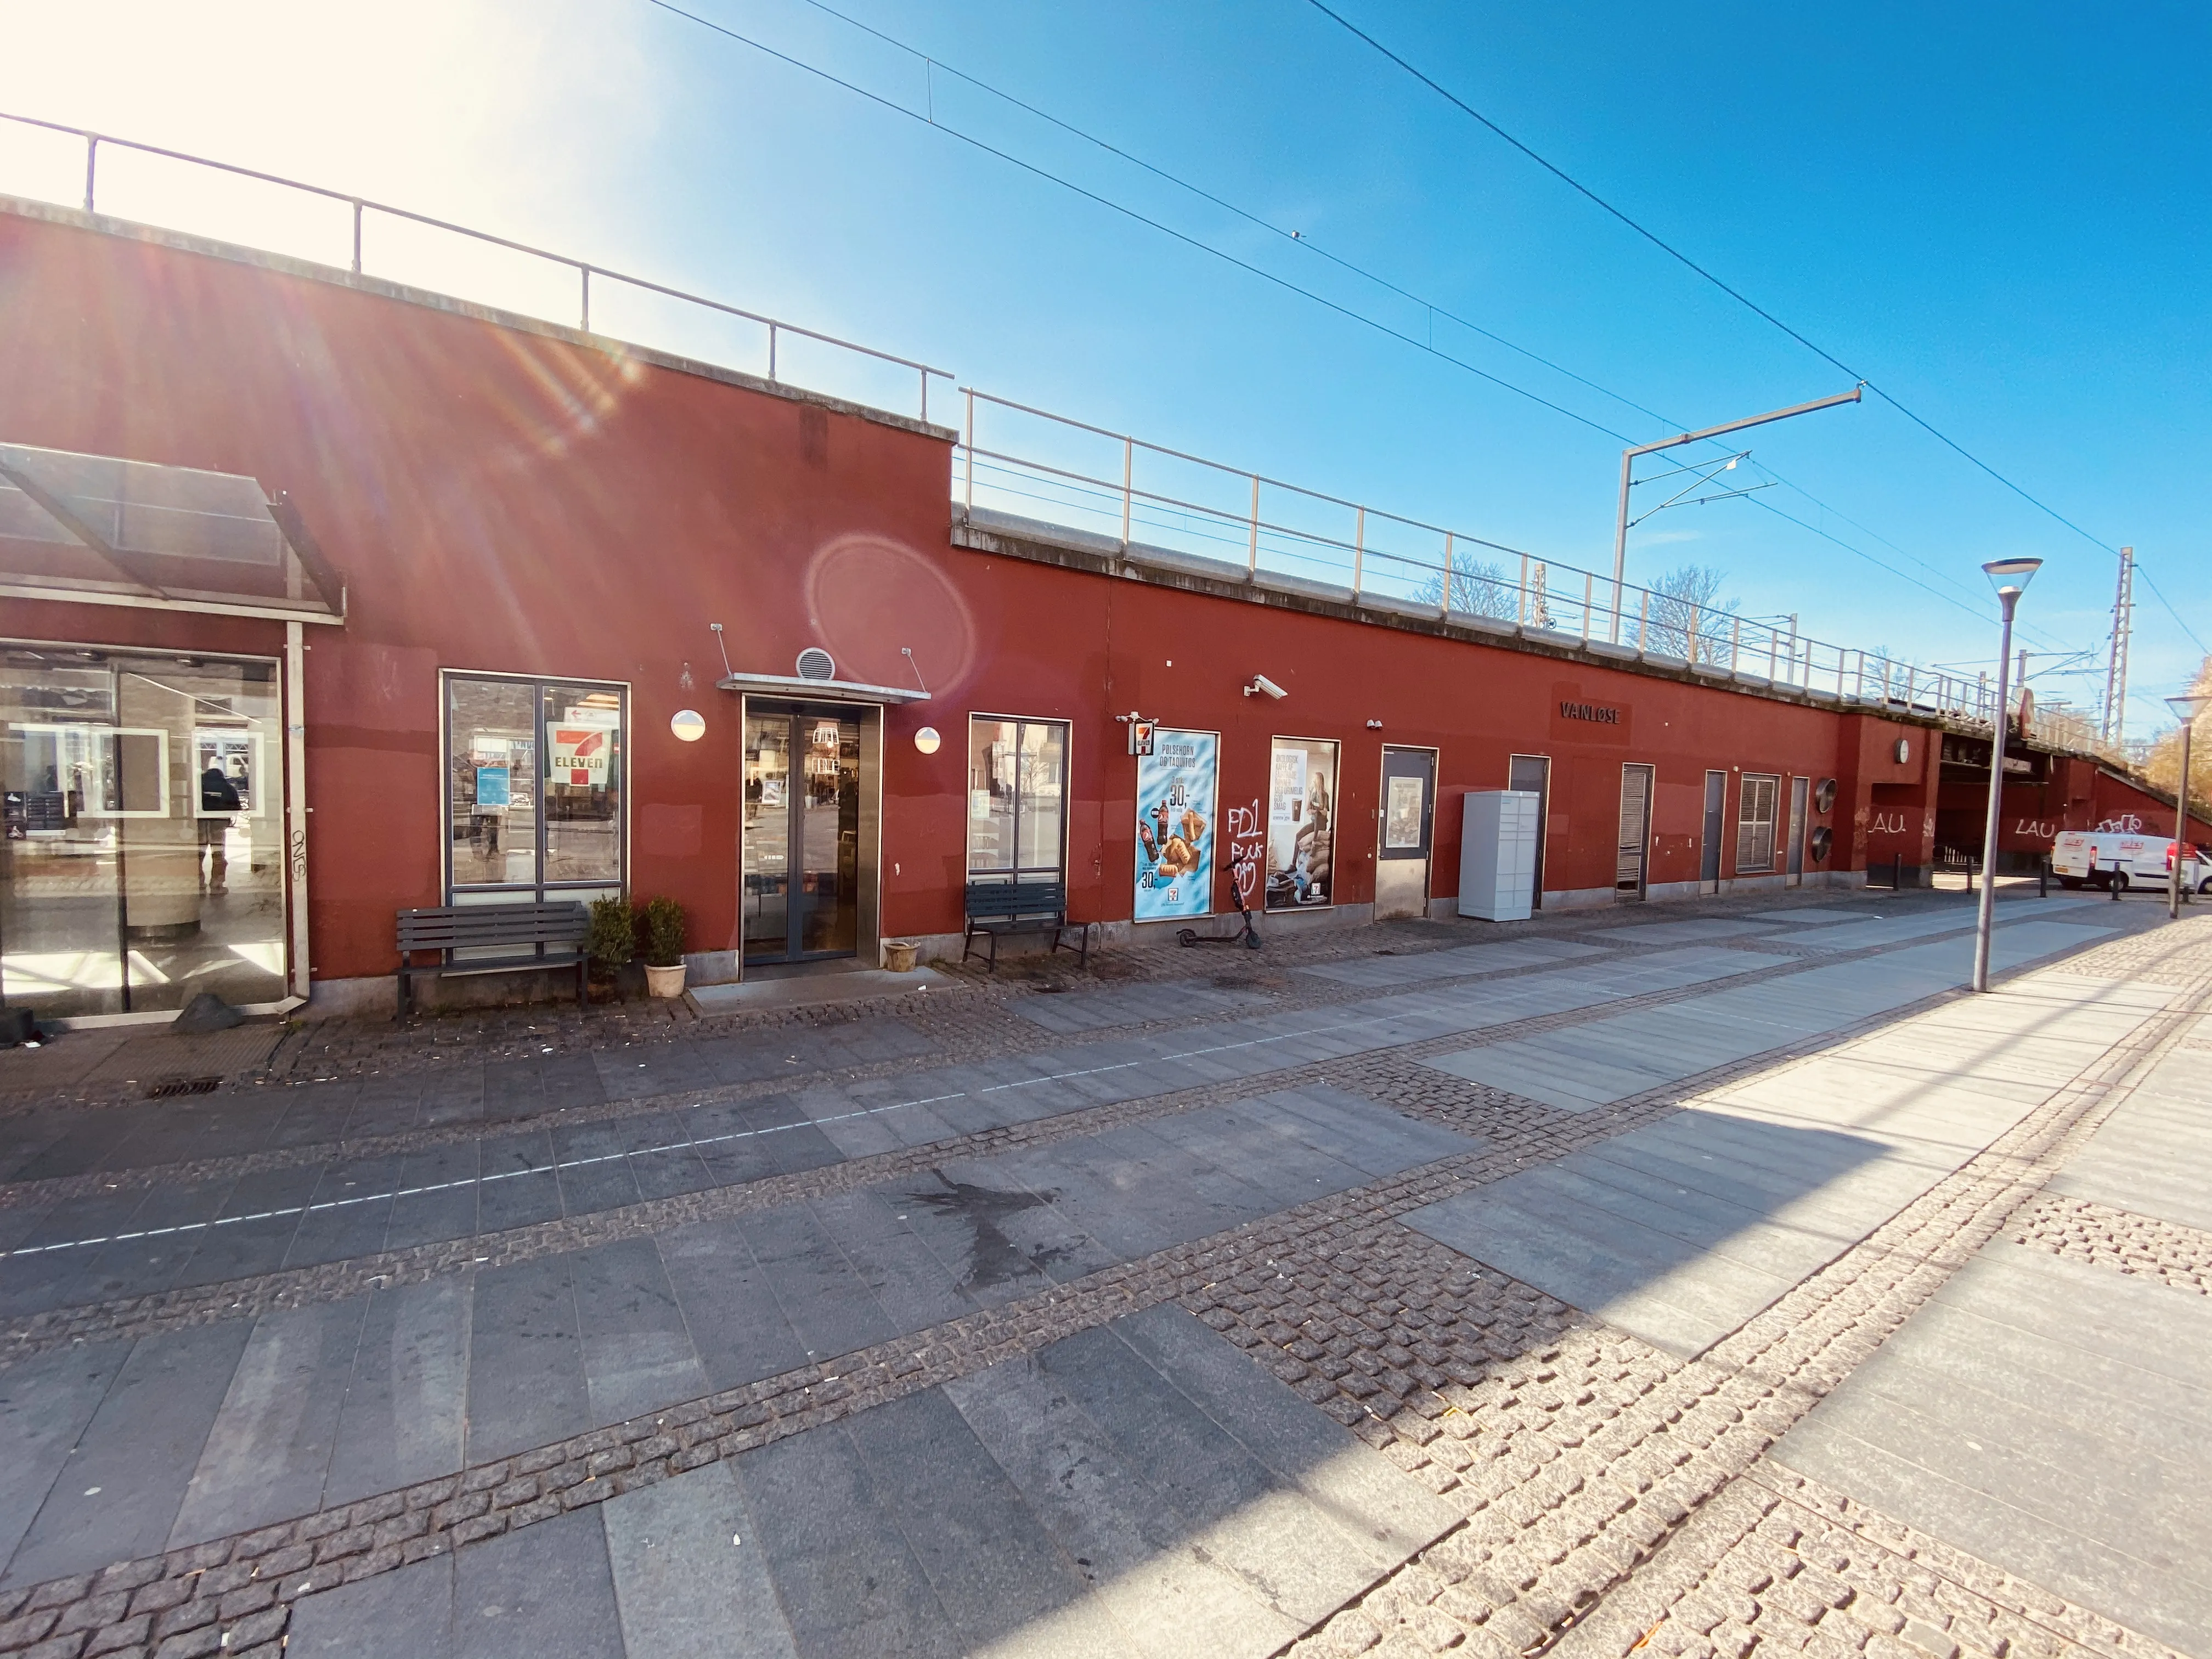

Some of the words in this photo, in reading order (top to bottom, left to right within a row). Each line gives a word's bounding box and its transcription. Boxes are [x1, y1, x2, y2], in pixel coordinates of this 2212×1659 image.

[1560, 701, 1622, 725] VANLØSE
[1162, 744, 1194, 756] PØLSEHORN
[1159, 756, 1167, 766] OG
[1169, 757, 1195, 768] TAQUITOS
[1276, 763, 1287, 771] KAFFE
[1171, 776, 1175, 784] 3
[1274, 786, 1283, 794] MED
[1273, 802, 1286, 810] SMAG
[2015, 819, 2055, 838] LAU
